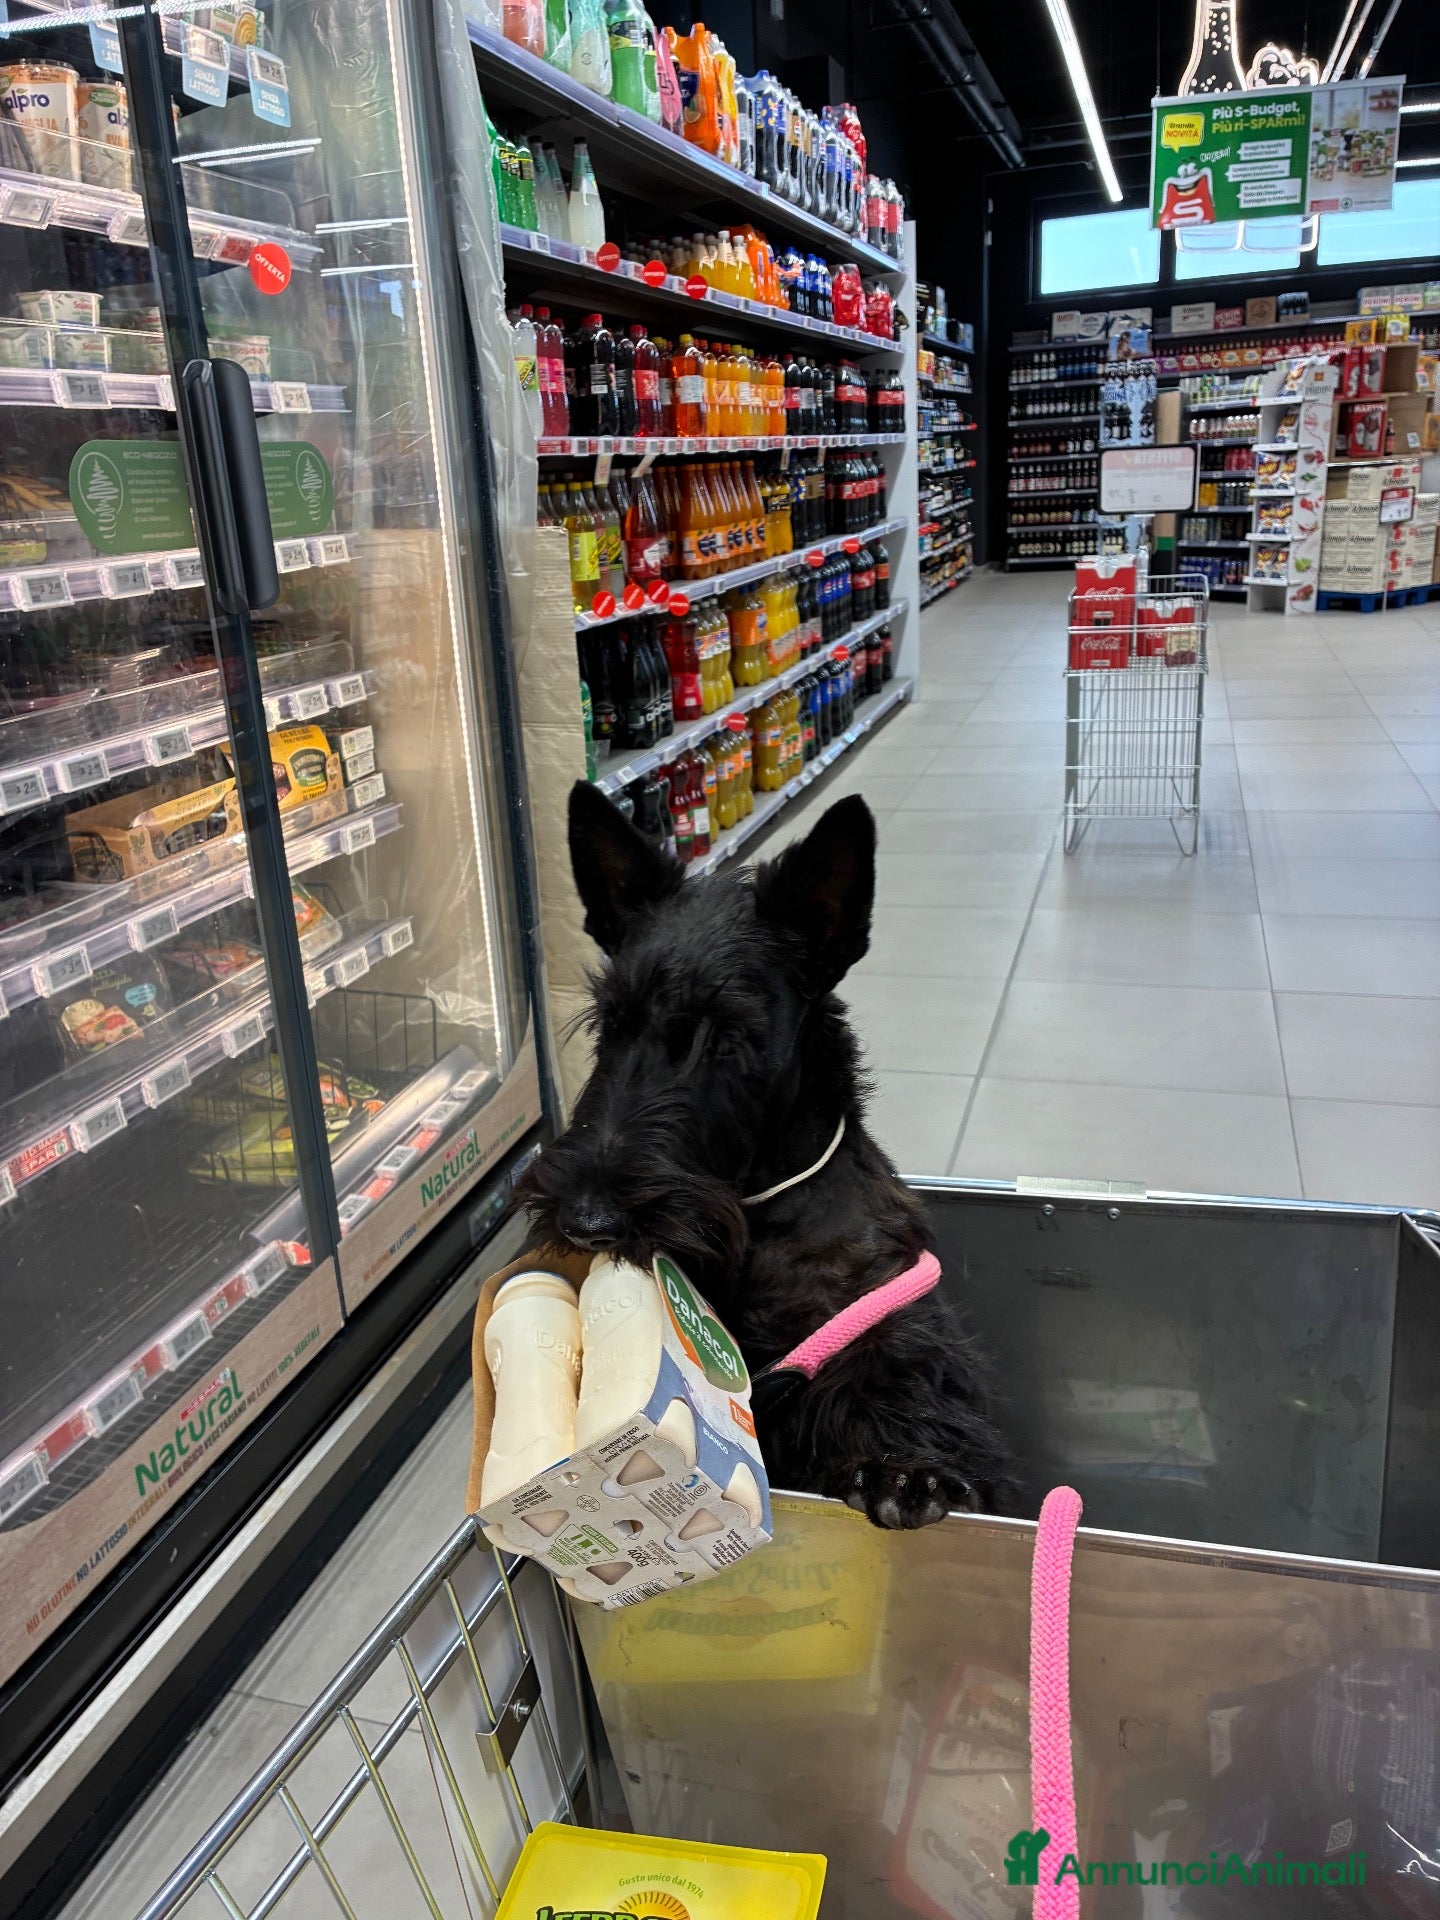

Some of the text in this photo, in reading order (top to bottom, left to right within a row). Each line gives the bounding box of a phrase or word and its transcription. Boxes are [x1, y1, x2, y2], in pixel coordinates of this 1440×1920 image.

[194, 68, 216, 85] SENZA
[188, 79, 221, 98] LATTOSIO
[260, 89, 280, 104] SENZA
[4, 89, 50, 112] alpro
[258, 99, 286, 118] LATTOSIO
[1212, 100, 1301, 120] Più S-Budget,
[1211, 114, 1306, 134] Più ri-SPARmi!
[254, 253, 286, 283] OFFERTA
[1080, 636, 1122, 651] Coca-Cola
[420, 1131, 480, 1208] Natural
[666, 1274, 740, 1379] Danacol
[134, 1370, 243, 1497] Natural
[702, 1426, 729, 1455] BLANCO
[627, 1549, 650, 1568] 400g
[26, 1616, 40, 1634] NO
[39, 1575, 78, 1619] GLUTINE
[75, 1563, 89, 1582] NO
[88, 1522, 129, 1570] LATTOSIO
[618, 1872, 705, 1899] Gusto unico dal 1974
